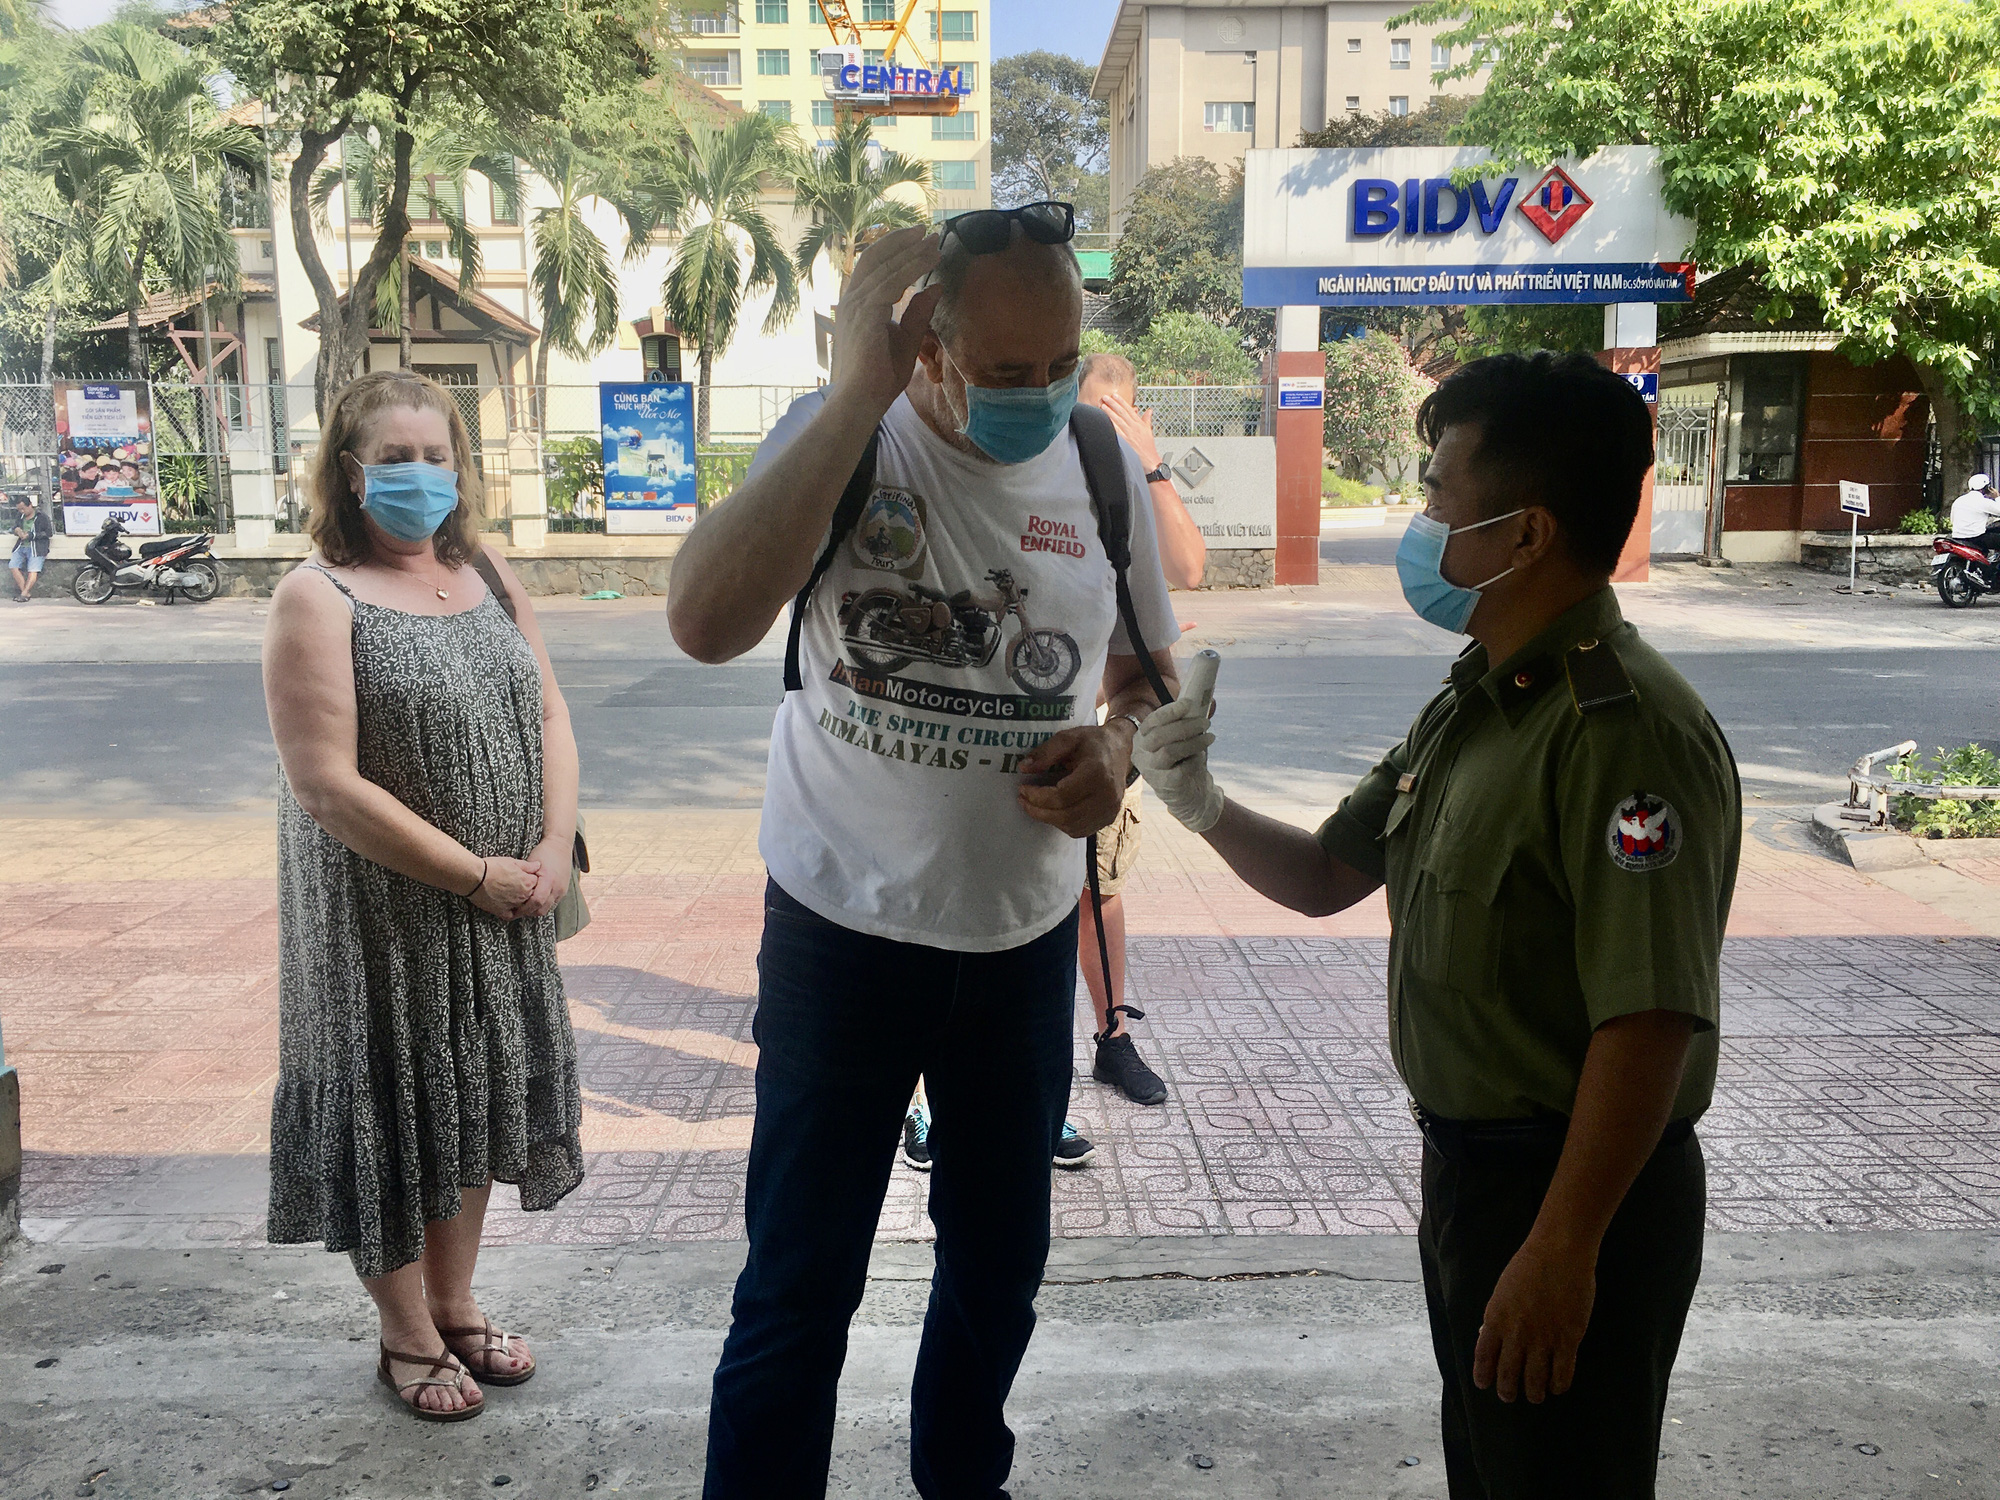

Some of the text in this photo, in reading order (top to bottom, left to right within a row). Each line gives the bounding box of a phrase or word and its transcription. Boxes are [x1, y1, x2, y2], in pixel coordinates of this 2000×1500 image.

[840, 64, 971, 95] CENTRAL
[1354, 178, 1519, 234] BIDV
[1319, 274, 1354, 293] NGÂN
[1356, 273, 1391, 293] HÀNG
[1393, 276, 1426, 292] TMCP
[1428, 271, 1454, 292] ĐẦU
[1457, 273, 1476, 291] TƯ
[1476, 272, 1493, 291] VÀ
[1494, 271, 1526, 291] PHÁT
[1527, 268, 1562, 290] TRIỂN
[1563, 271, 1590, 293] VIỆT
[1593, 274, 1623, 289] NAM
[1627, 374, 1644, 391] 9
[613, 392, 639, 402] CÙNG
[109, 511, 138, 521] BIDV
[1028, 515, 1078, 539] ROYAL
[1020, 535, 1086, 559] ENFIELD
[871, 557, 895, 569] Tours
[817, 708, 969, 770] HIMALAYAS
[887, 714, 951, 741] SPITI
[957, 727, 1053, 748] CIRCUIT
